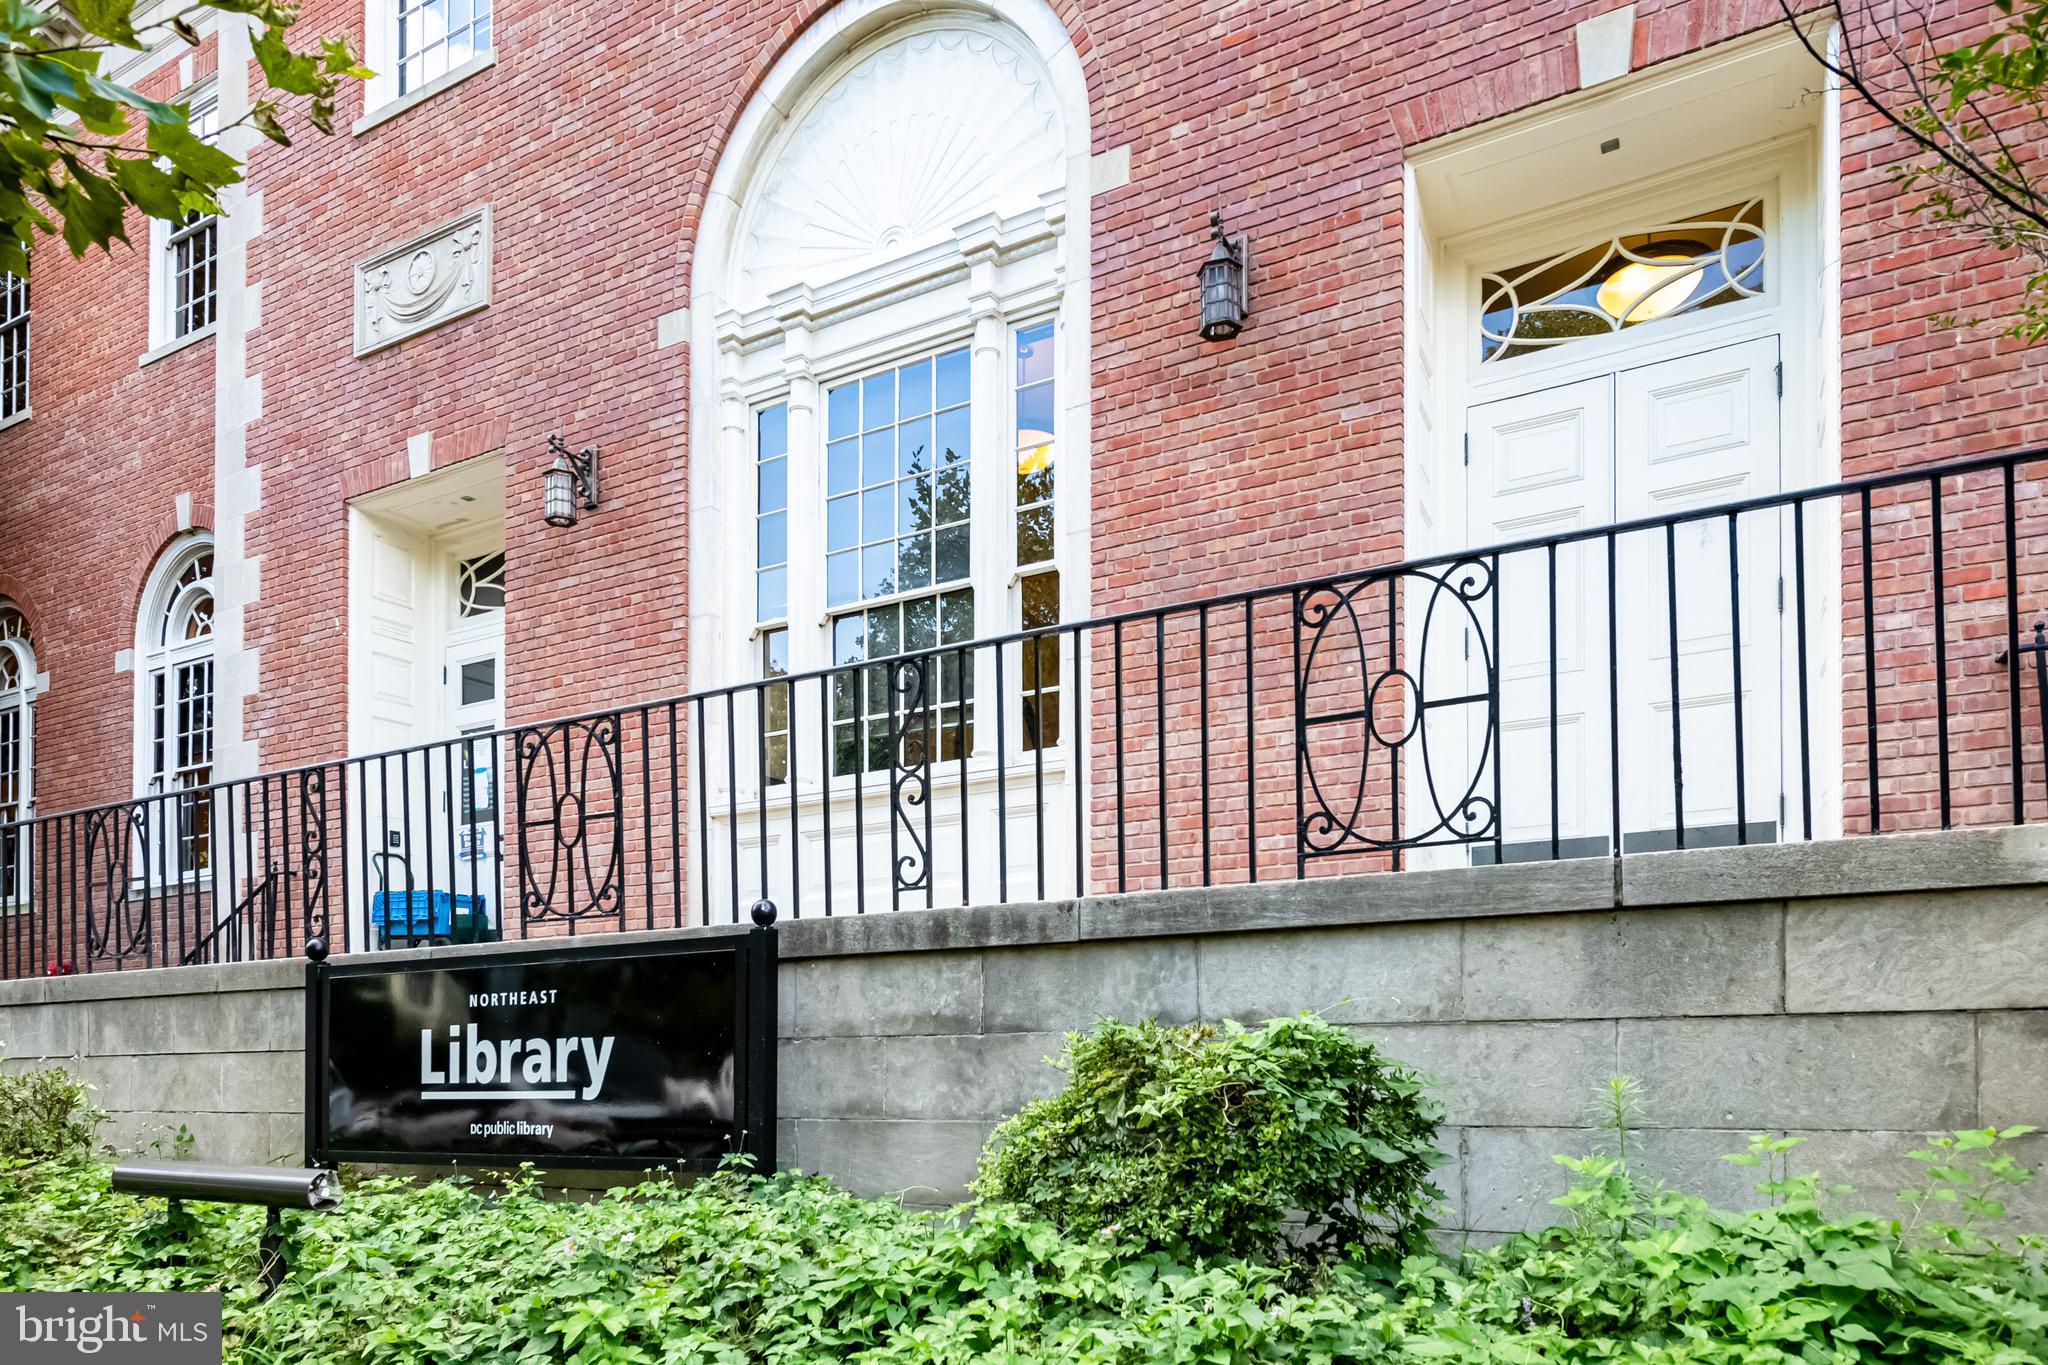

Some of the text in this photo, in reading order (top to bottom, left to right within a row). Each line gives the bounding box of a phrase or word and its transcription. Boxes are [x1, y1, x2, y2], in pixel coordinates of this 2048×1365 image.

[469, 989, 558, 1008] NORTHEAST
[421, 1023, 615, 1101] Library
[470, 1120, 554, 1139] DC public library
